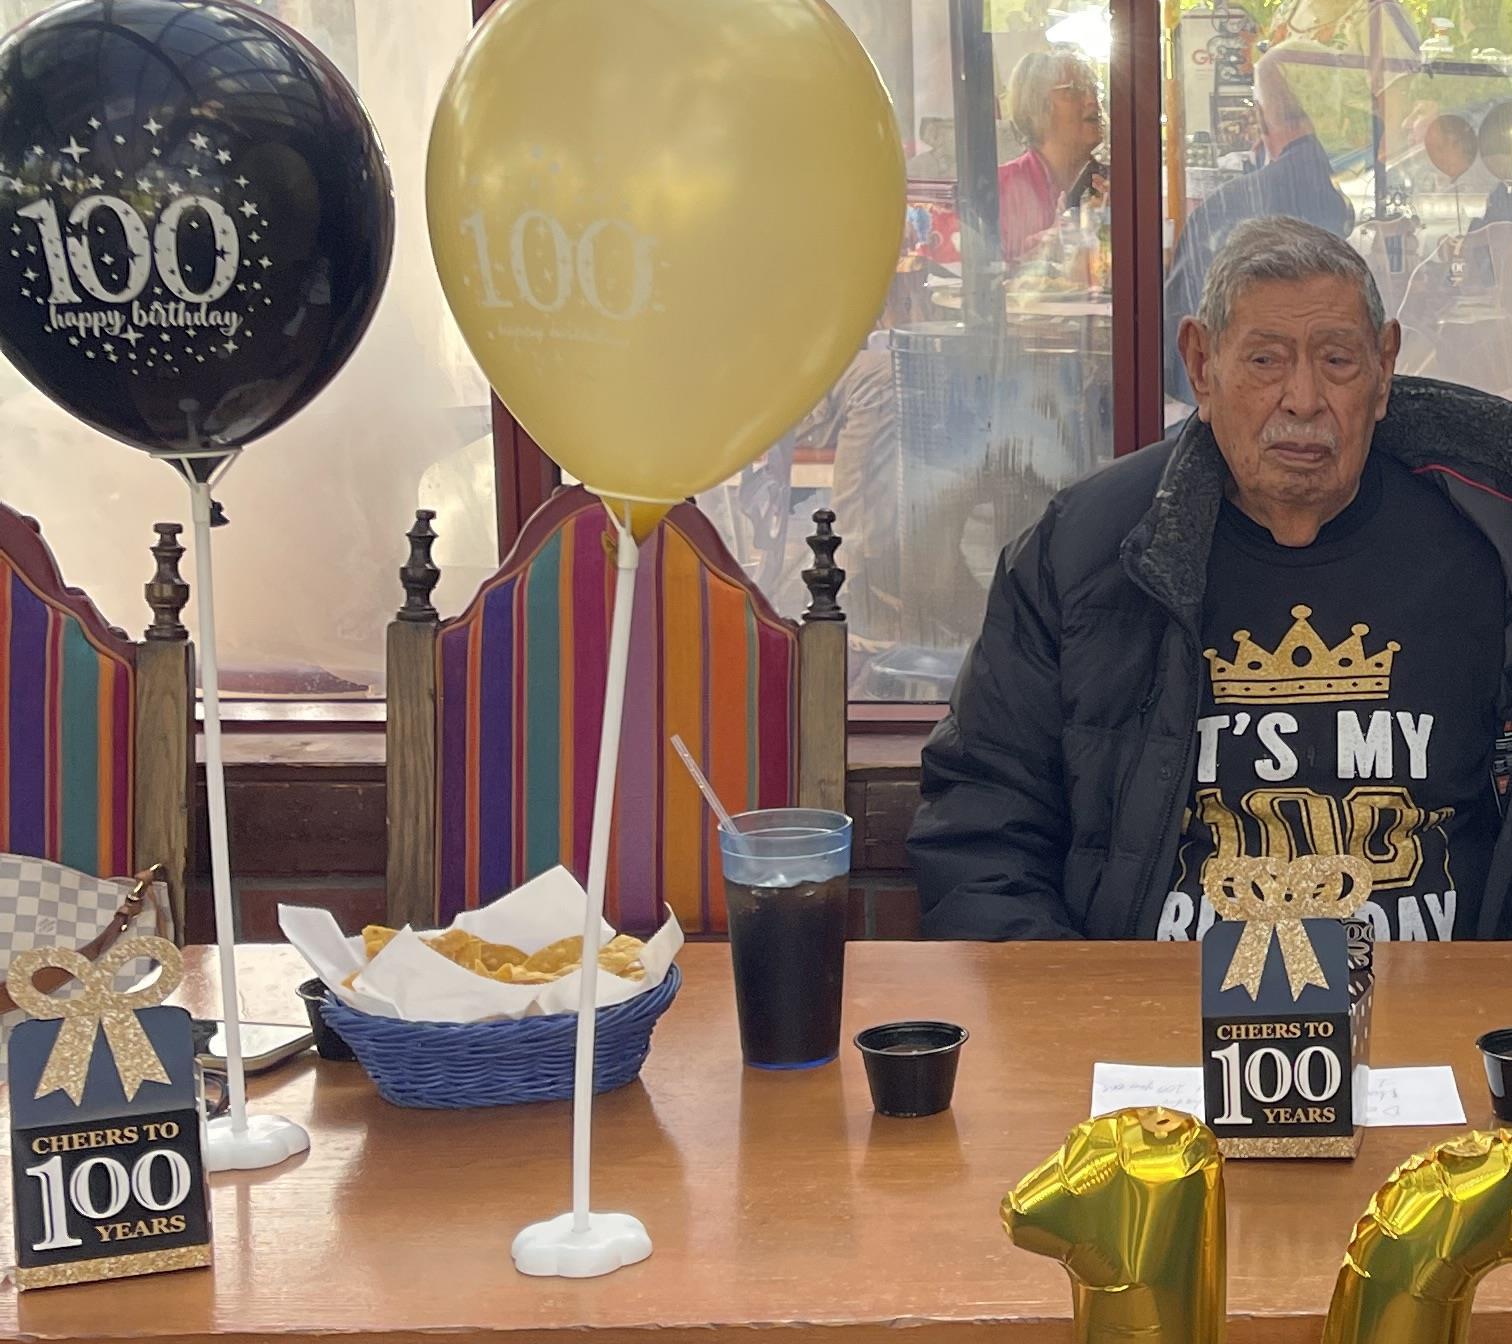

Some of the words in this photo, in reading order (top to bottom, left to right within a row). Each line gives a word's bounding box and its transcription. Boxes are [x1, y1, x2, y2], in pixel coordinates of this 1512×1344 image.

[16, 195, 240, 305] 100
[460, 207, 658, 323] 100
[49, 302, 126, 338] happy
[131, 299, 243, 337] birthday
[1336, 709, 1435, 781] MY
[1216, 1022, 1301, 1041] CHEERS
[1304, 1022, 1334, 1038] TO
[1211, 1042, 1342, 1125] 100
[32, 1126, 138, 1155] CHEERS
[143, 1121, 180, 1140] TO
[1262, 1107, 1336, 1124] YEARS
[25, 1148, 192, 1252] 100
[94, 1214, 187, 1242] YEARS
